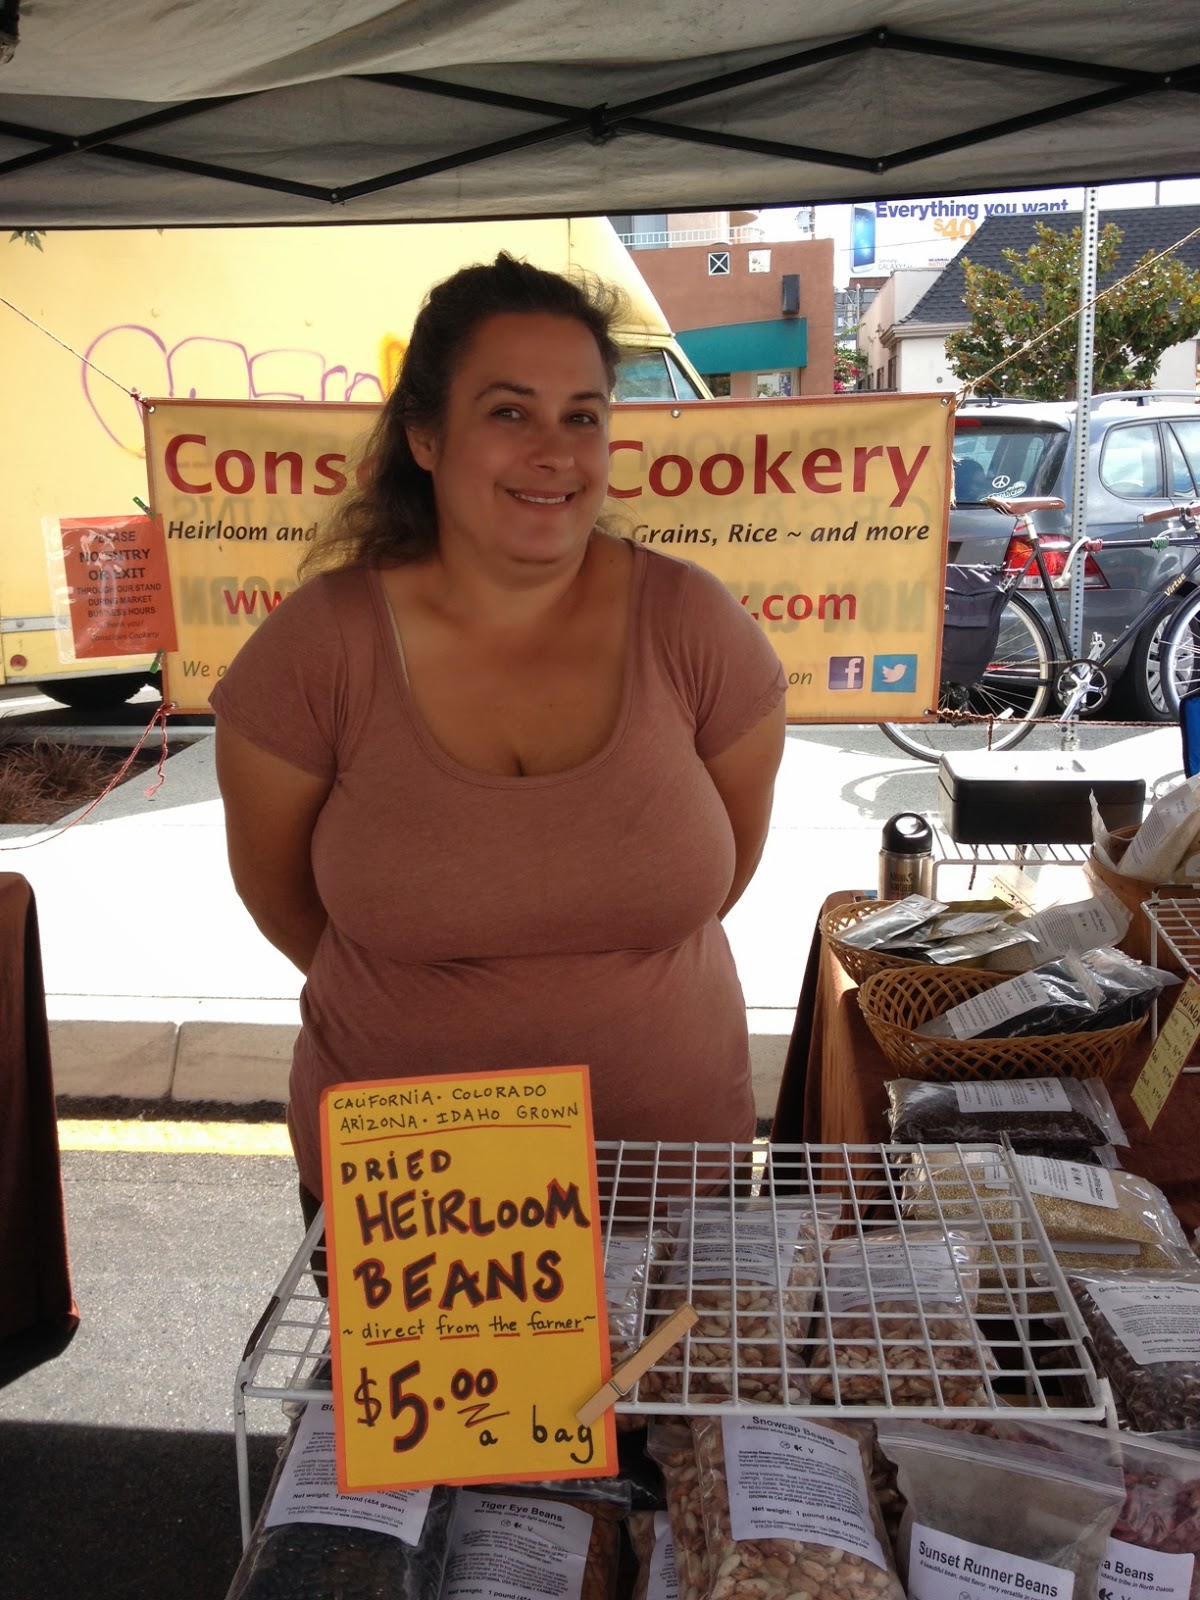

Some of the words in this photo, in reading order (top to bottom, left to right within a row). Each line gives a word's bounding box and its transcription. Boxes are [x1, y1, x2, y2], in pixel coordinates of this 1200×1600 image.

[875, 200, 978, 220] Everything
[984, 201, 1017, 214] you
[1022, 199, 1068, 212] want
[933, 218, 976, 241] $40
[606, 434, 931, 508] Cookery
[168, 521, 268, 541] Heirloom
[276, 522, 318, 542] and
[632, 524, 718, 546] Grains,
[728, 523, 778, 543] Rice
[811, 522, 857, 542] and
[865, 523, 930, 542] more
[113, 567, 146, 579] EXIT
[117, 584, 133, 593] OUR
[135, 583, 162, 592] STAND
[1164, 573, 1187, 597] Virtue
[120, 595, 152, 604] MARKET
[128, 606, 156, 615] HOURS
[740, 593, 857, 622] .com
[183, 660, 210, 677] We
[789, 672, 812, 686] on
[452, 1084, 547, 1100] COLORADO
[436, 1109, 500, 1125] IDAHO
[516, 1103, 579, 1119] GROWN
[353, 1250, 564, 1312] BEANS
[362, 1317, 425, 1339] direct
[435, 1315, 480, 1336] from
[493, 1315, 517, 1333] the
[479, 1428, 498, 1447] a
[532, 1404, 594, 1464] bag
[752, 1416, 801, 1433] Snowcap
[803, 1425, 835, 1445] Beans
[341, 1495, 363, 1503] pound
[480, 1501, 507, 1511] Tiger
[509, 1504, 528, 1514] Eye
[531, 1507, 563, 1522] Beans
[802, 1511, 825, 1520] pound
[918, 1541, 961, 1569] Sunset
[963, 1557, 1013, 1585] Runner
[1014, 1572, 1059, 1598] Beans
[1101, 1560, 1111, 1570] a
[1115, 1561, 1154, 1582] Beans
[958, 1572, 971, 1583] mild
[988, 1582, 1001, 1593] very
[1001, 1586, 1024, 1600] versatile
[1118, 1578, 1131, 1587] tribe
[1138, 1583, 1155, 1592] North
